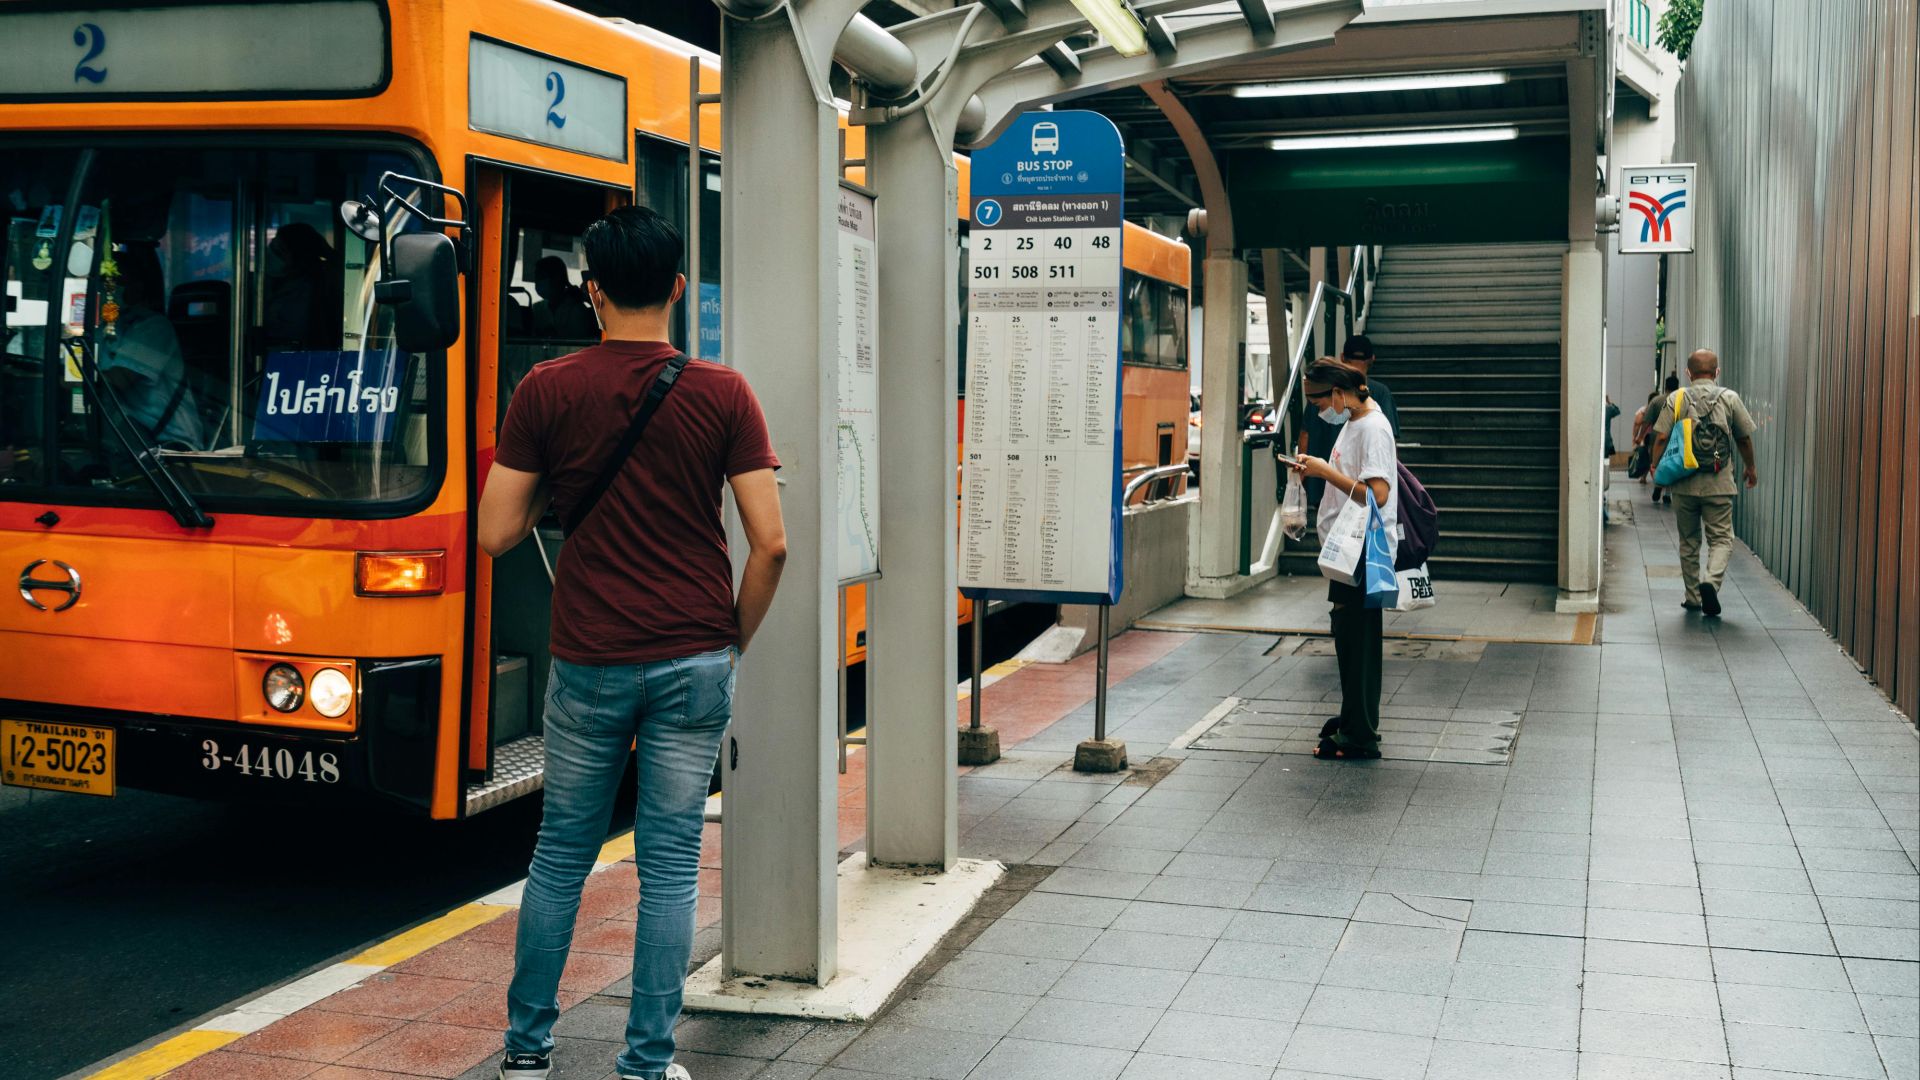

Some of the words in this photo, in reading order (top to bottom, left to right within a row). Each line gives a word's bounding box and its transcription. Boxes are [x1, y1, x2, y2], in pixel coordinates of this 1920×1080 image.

[73, 23, 107, 84] 2
[545, 71, 567, 130] 2
[1017, 161, 1040, 171] BUS
[1043, 160, 1073, 171] STOP
[1631, 175, 1686, 185] BTS
[985, 206, 994, 219] 7
[1026, 215, 1038, 223] Chit
[1039, 215, 1052, 223] Lom
[1053, 214, 1074, 222] Station
[984, 238, 992, 250] 2
[1016, 238, 1034, 250] 25
[1054, 237, 1072, 249] 40
[1092, 236, 1110, 248] 48
[974, 266, 999, 279] 501
[1012, 266, 1038, 279] 508
[1050, 266, 1075, 278] 511
[266, 369, 399, 415] ไปสำโรง
[26, 724, 87, 738] THAILAND
[10, 734, 106, 775] 12-5023
[202, 740, 340, 784] 3-44048
